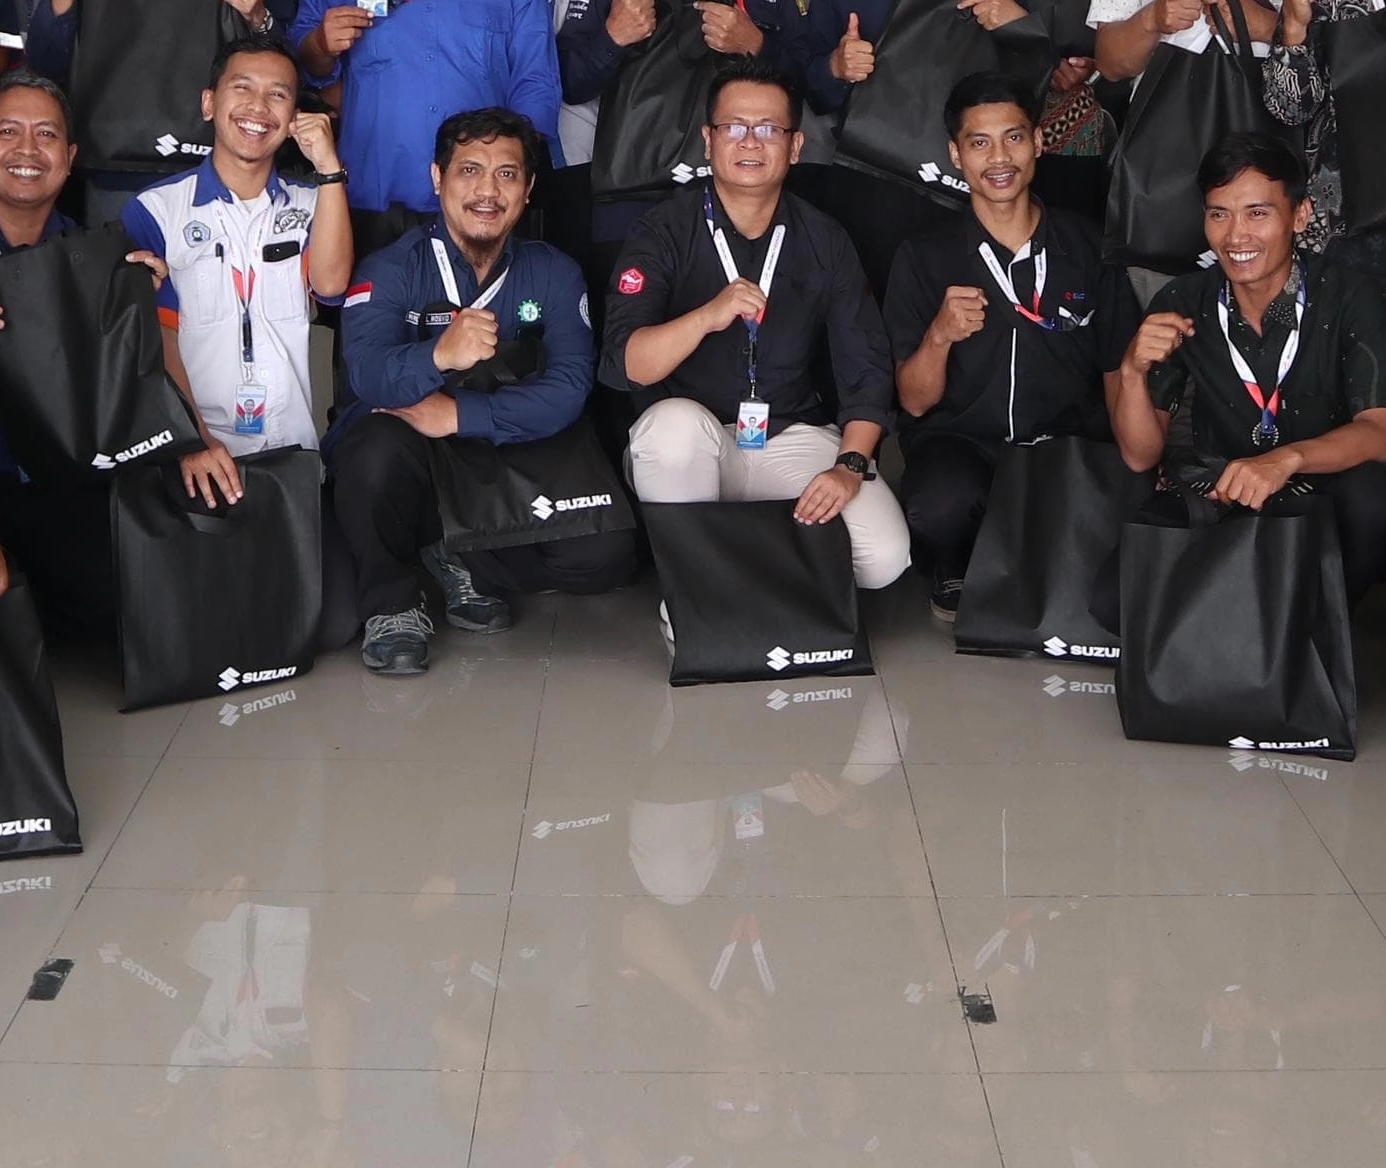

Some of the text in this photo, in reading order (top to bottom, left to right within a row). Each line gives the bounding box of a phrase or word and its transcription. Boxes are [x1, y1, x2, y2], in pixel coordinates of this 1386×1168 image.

[180, 142, 214, 156] SUZ
[940, 174, 972, 194] SUZ
[115, 429, 174, 464] SUZUKI
[554, 493, 612, 512] SUZUKI
[792, 648, 854, 665] SUZUKI
[1069, 644, 1121, 658] SUZU
[241, 665, 297, 685] SUZUKI
[1258, 737, 1330, 750] SUZUKI
